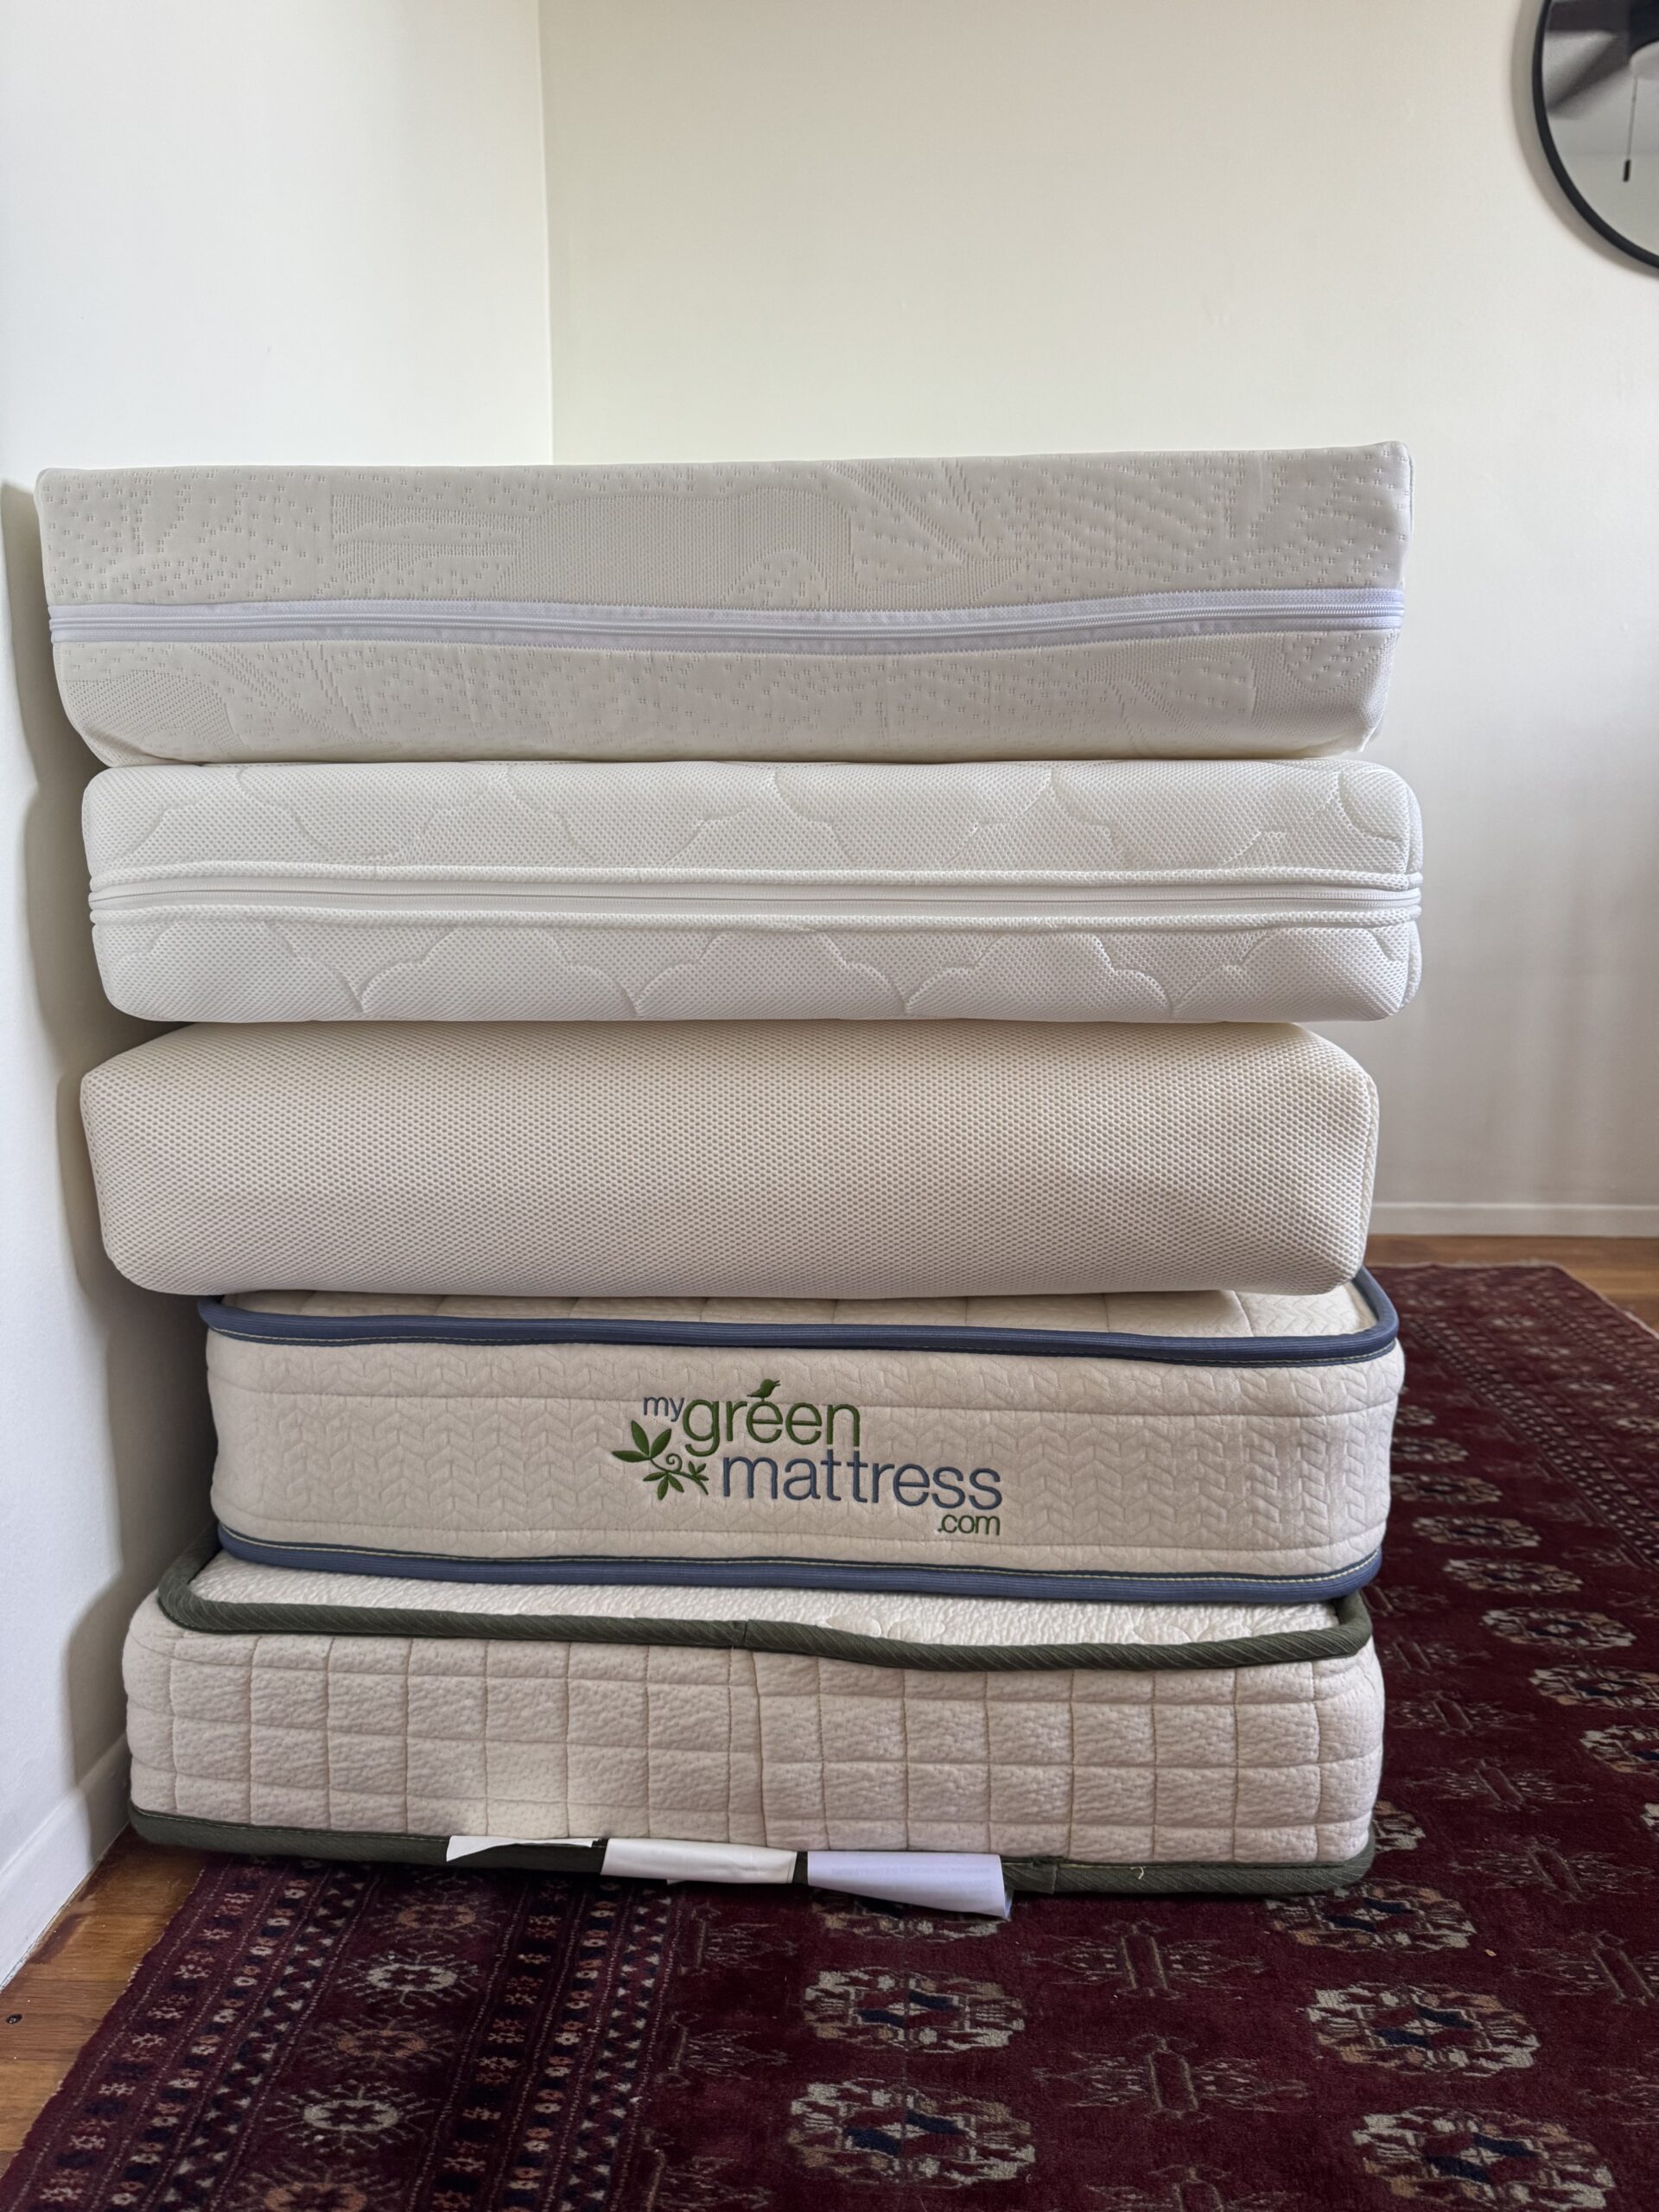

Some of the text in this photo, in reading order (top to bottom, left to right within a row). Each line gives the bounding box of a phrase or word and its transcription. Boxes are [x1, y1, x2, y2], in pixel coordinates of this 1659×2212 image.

[643, 1395, 860, 1457] my green
[723, 1448, 1002, 1510] mattress
[937, 1513, 1001, 1535] .com
